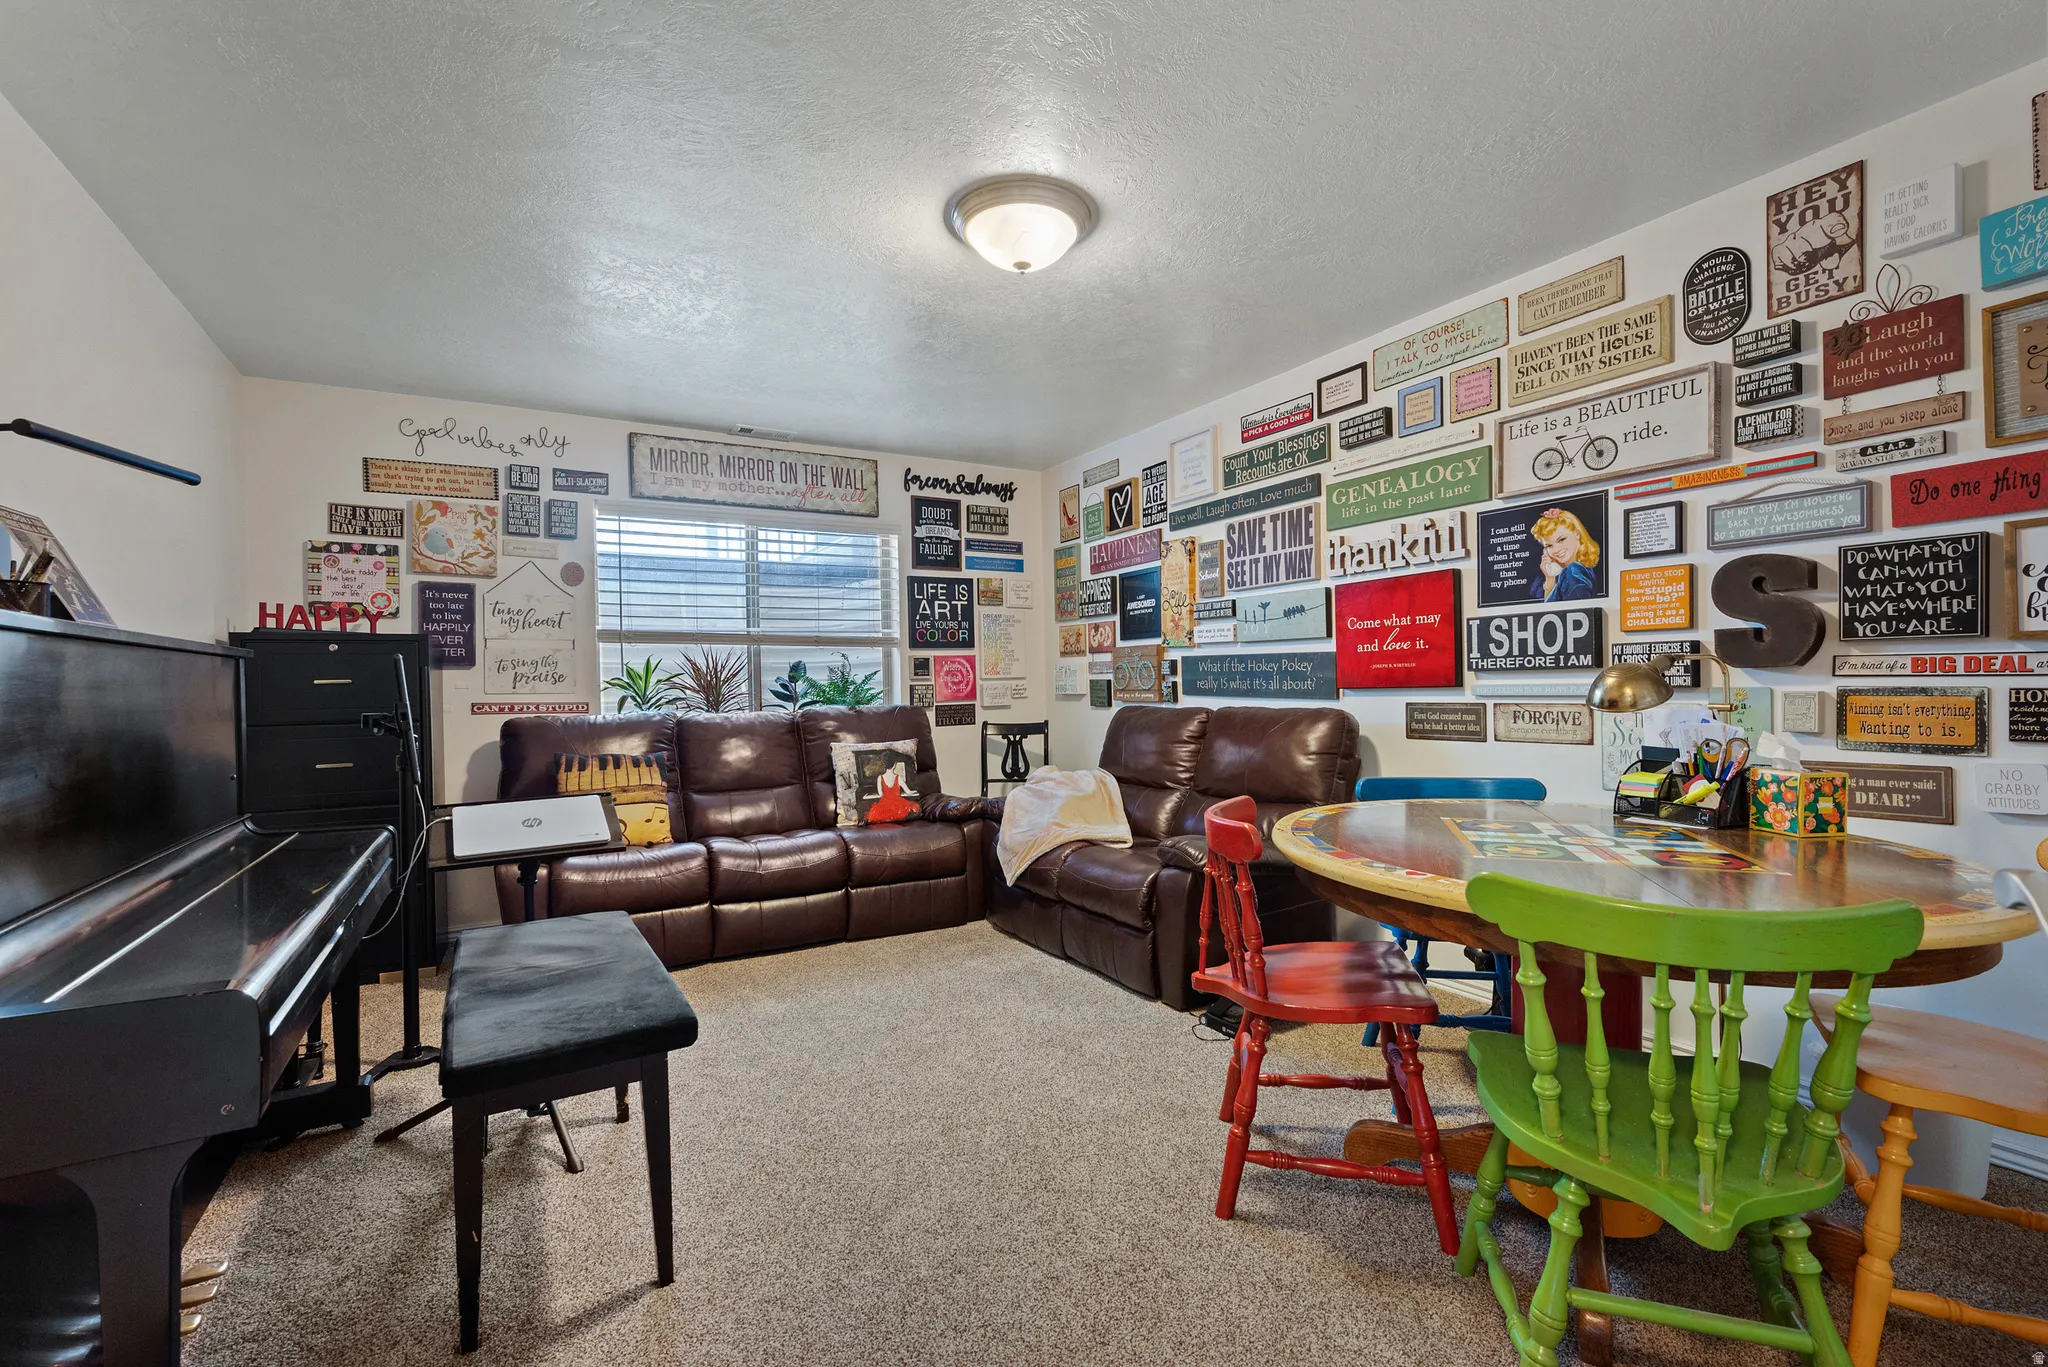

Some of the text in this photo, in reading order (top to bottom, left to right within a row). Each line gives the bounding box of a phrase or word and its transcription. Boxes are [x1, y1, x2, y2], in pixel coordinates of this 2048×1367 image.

[1773, 170, 1855, 217] HEY
[1885, 179, 1929, 204] I'M GETTING
[1772, 191, 1851, 235] YOU
[1884, 215, 1916, 234] OF FOOD
[1884, 219, 1948, 249] HAVING CALORIES
[1694, 264, 1736, 284] CHALLENGE
[1785, 267, 1840, 293] GET
[1533, 285, 1606, 321] CAN'T REMEMBER
[1688, 277, 1744, 310] BATTLE
[1776, 275, 1858, 311] BUSY!
[1403, 319, 1465, 351] OF COURSE!
[1695, 317, 1739, 336] UNARMED
[1865, 312, 1933, 343] Laugh
[1387, 361, 1390, 370] I
[1395, 351, 1419, 368] TALK
[1424, 343, 1438, 355] TO
[1515, 344, 1656, 394] FELL ON MY SISTER.
[1833, 351, 1954, 388] laughs with you
[1508, 378, 1703, 440] Life is a BEAUTIFUL
[1738, 408, 1792, 428] A PENNY FOR
[1249, 413, 1304, 436] PICK A GOOD ONE
[1622, 421, 1668, 443] ride.
[1224, 456, 1248, 473] Count
[1252, 446, 1273, 463] Your
[1278, 430, 1325, 457] Blessings
[1866, 441, 1908, 455] A.S.A.P.
[511, 472, 538, 483] BE ODD
[650, 447, 867, 491] MIRROR, MIRROR ON THE WALL
[555, 477, 606, 486] MULTI-SLACKING
[1332, 456, 1483, 505] GENEALOGY
[1910, 467, 2041, 505] Do one thing
[509, 494, 539, 505] CHOCOLATE
[1145, 483, 1164, 506] AGE
[1171, 515, 1185, 526] Live
[1206, 502, 1229, 518] Laugh
[1232, 495, 1258, 510] often,
[1260, 490, 1282, 503] Love
[1284, 483, 1312, 497] much
[1342, 485, 1471, 519] life in the past lane
[331, 505, 402, 521] LIFE IS SHORT
[922, 506, 952, 520] DOUBT
[331, 523, 402, 537] HAVE TEETH
[926, 526, 950, 536] DREAMS
[1227, 505, 1313, 560] SAVE TIME
[1511, 524, 1525, 532] still
[1091, 531, 1159, 565] HAPPINESS
[1324, 511, 1469, 577] thankful
[1490, 534, 1527, 544] remember
[919, 543, 953, 556] FAILURE
[1494, 561, 1523, 569] smarter
[1858, 560, 1963, 580] CAN WITH
[914, 583, 968, 600] LIFE IS
[1080, 578, 1111, 603] HAPPINESS
[1504, 579, 1527, 587] phone
[1645, 582, 1684, 594] stupid
[425, 590, 440, 599] It's
[1127, 599, 1156, 610] AWESOMED
[259, 602, 384, 633] HAPPY
[489, 600, 524, 618] tune
[916, 600, 968, 620] ART
[1712, 553, 1826, 668] S
[423, 623, 471, 632] HAPPILY
[500, 608, 571, 633] my heart
[1347, 613, 1441, 630] Come what may
[1627, 616, 1685, 626] CHALLENGE!
[1854, 621, 1896, 637] YOU
[916, 629, 968, 642] COLOR
[1357, 628, 1429, 653] and love it.
[1469, 612, 1590, 658] I SHOP
[1199, 657, 1312, 675] What if the Hokey Pokey
[1470, 655, 1592, 669] THEREFORE I AM
[1911, 655, 2034, 673] BIG DEAL
[513, 671, 567, 689] praise
[473, 704, 587, 712] CAN'T FIX STUPID
[1414, 712, 1426, 720] First
[1428, 712, 1440, 720] God
[1440, 712, 1462, 721] created
[1512, 711, 1582, 730] FORGIVE
[1859, 720, 1962, 739] Wanting to is.
[2000, 769, 2023, 781] NO
[1988, 797, 2040, 810] ATTITUDES
